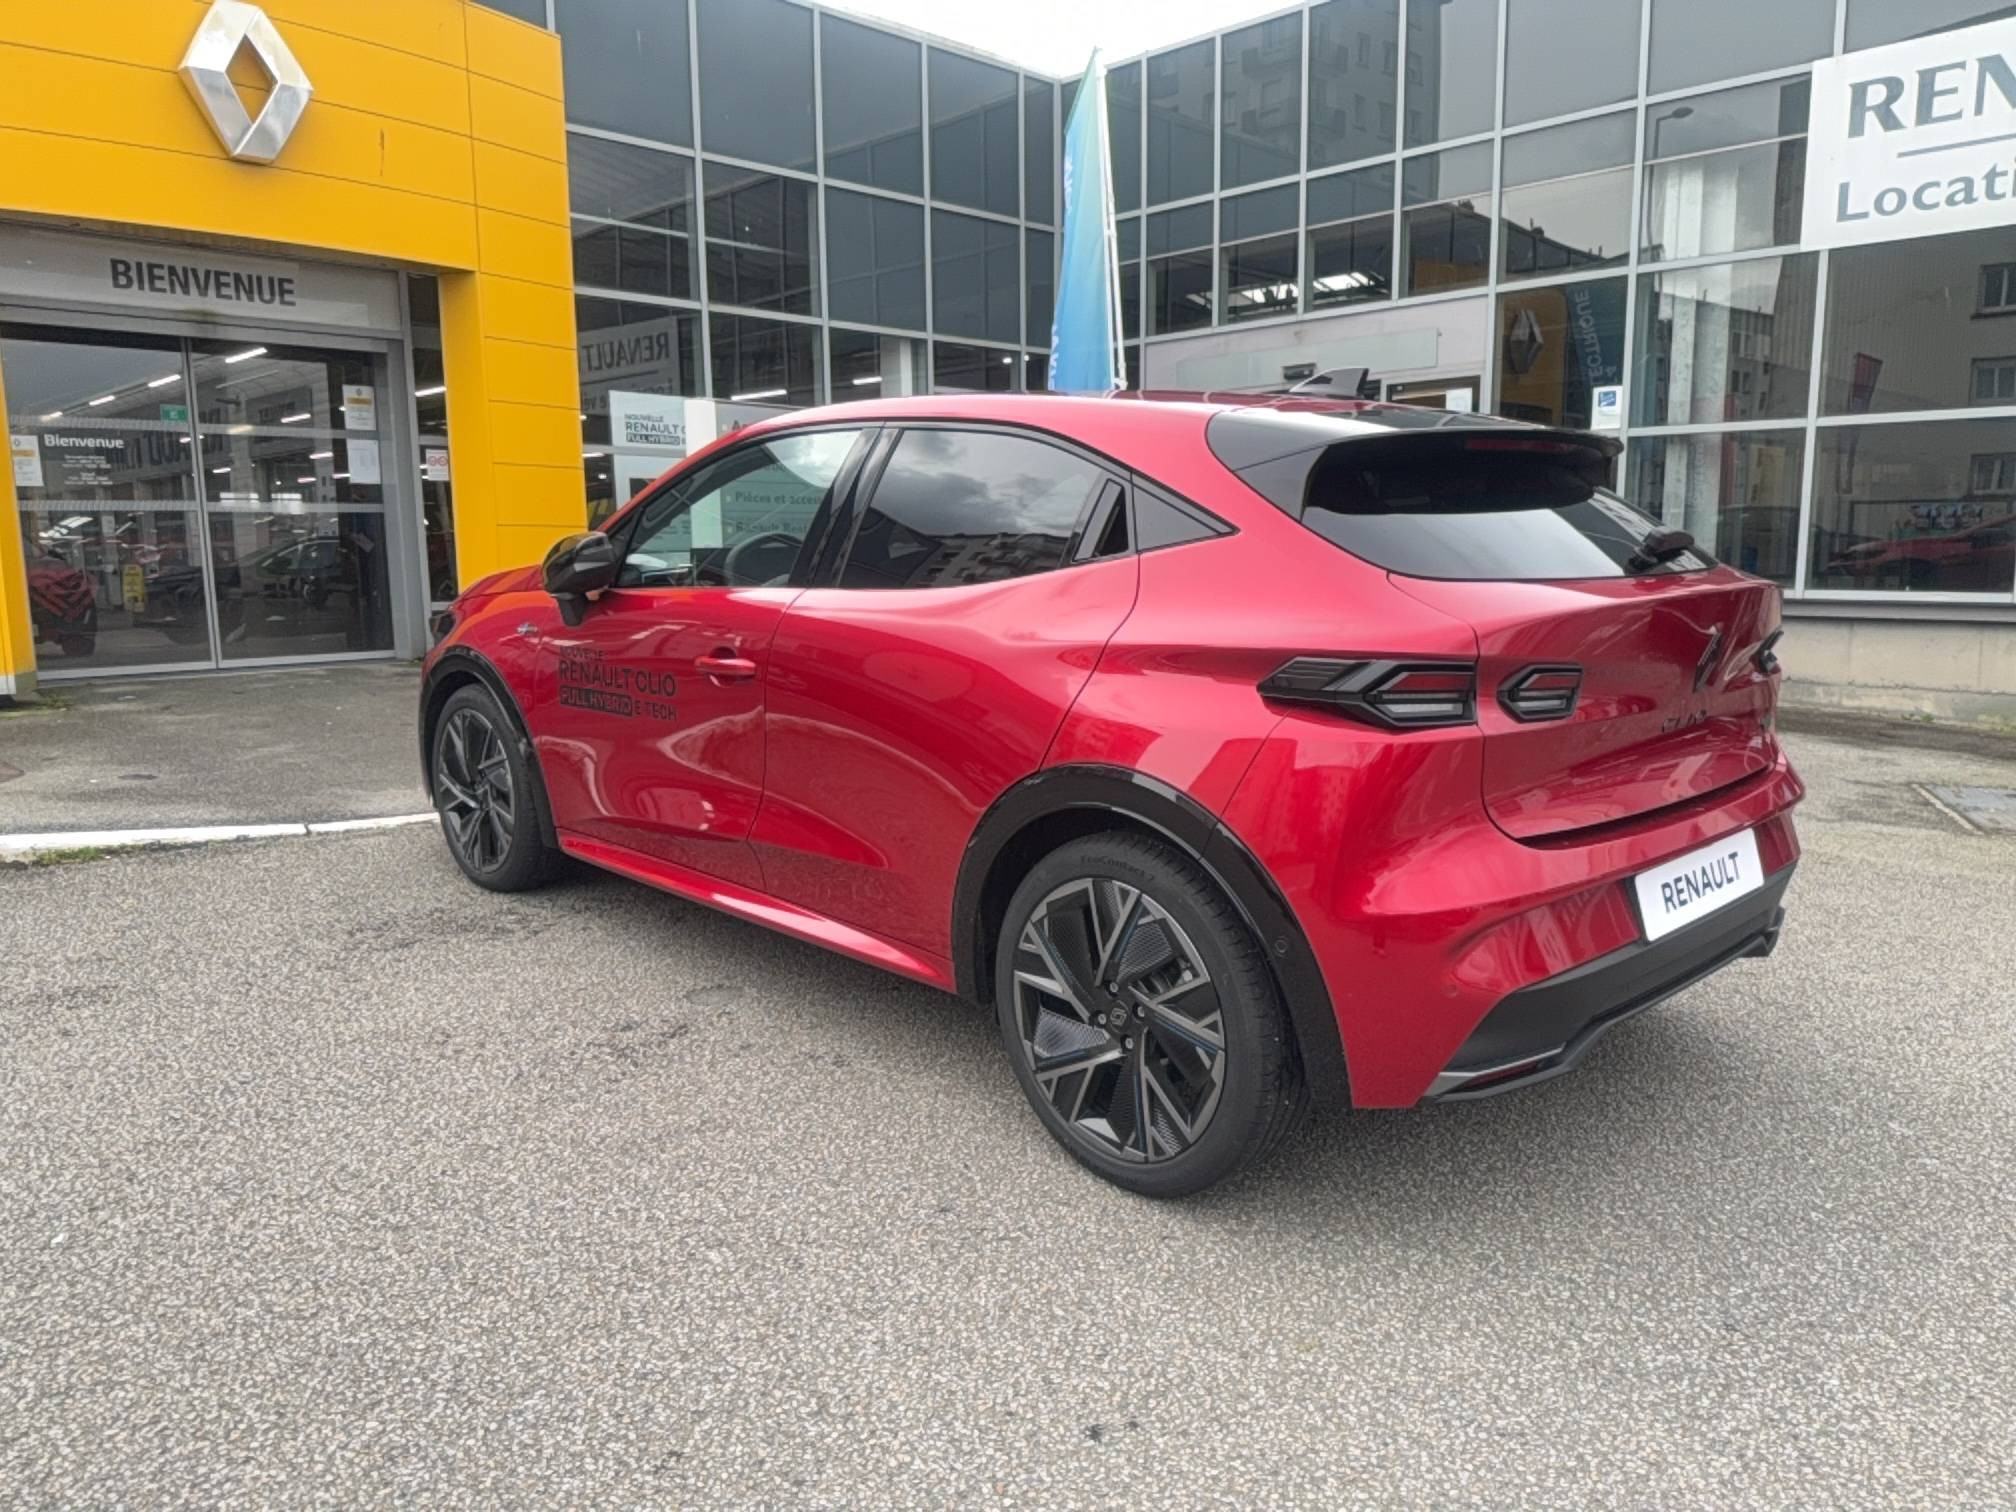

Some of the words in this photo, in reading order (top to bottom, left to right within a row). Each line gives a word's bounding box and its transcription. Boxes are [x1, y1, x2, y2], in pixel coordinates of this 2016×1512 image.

[110, 258, 297, 307] BIENVENUE
[44, 434, 125, 449] Bienvenue
[625, 421, 679, 434] RENAULT
[559, 660, 632, 689] RENAULT
[635, 670, 677, 697] CLIO
[1661, 851, 1740, 914] RENAULT
